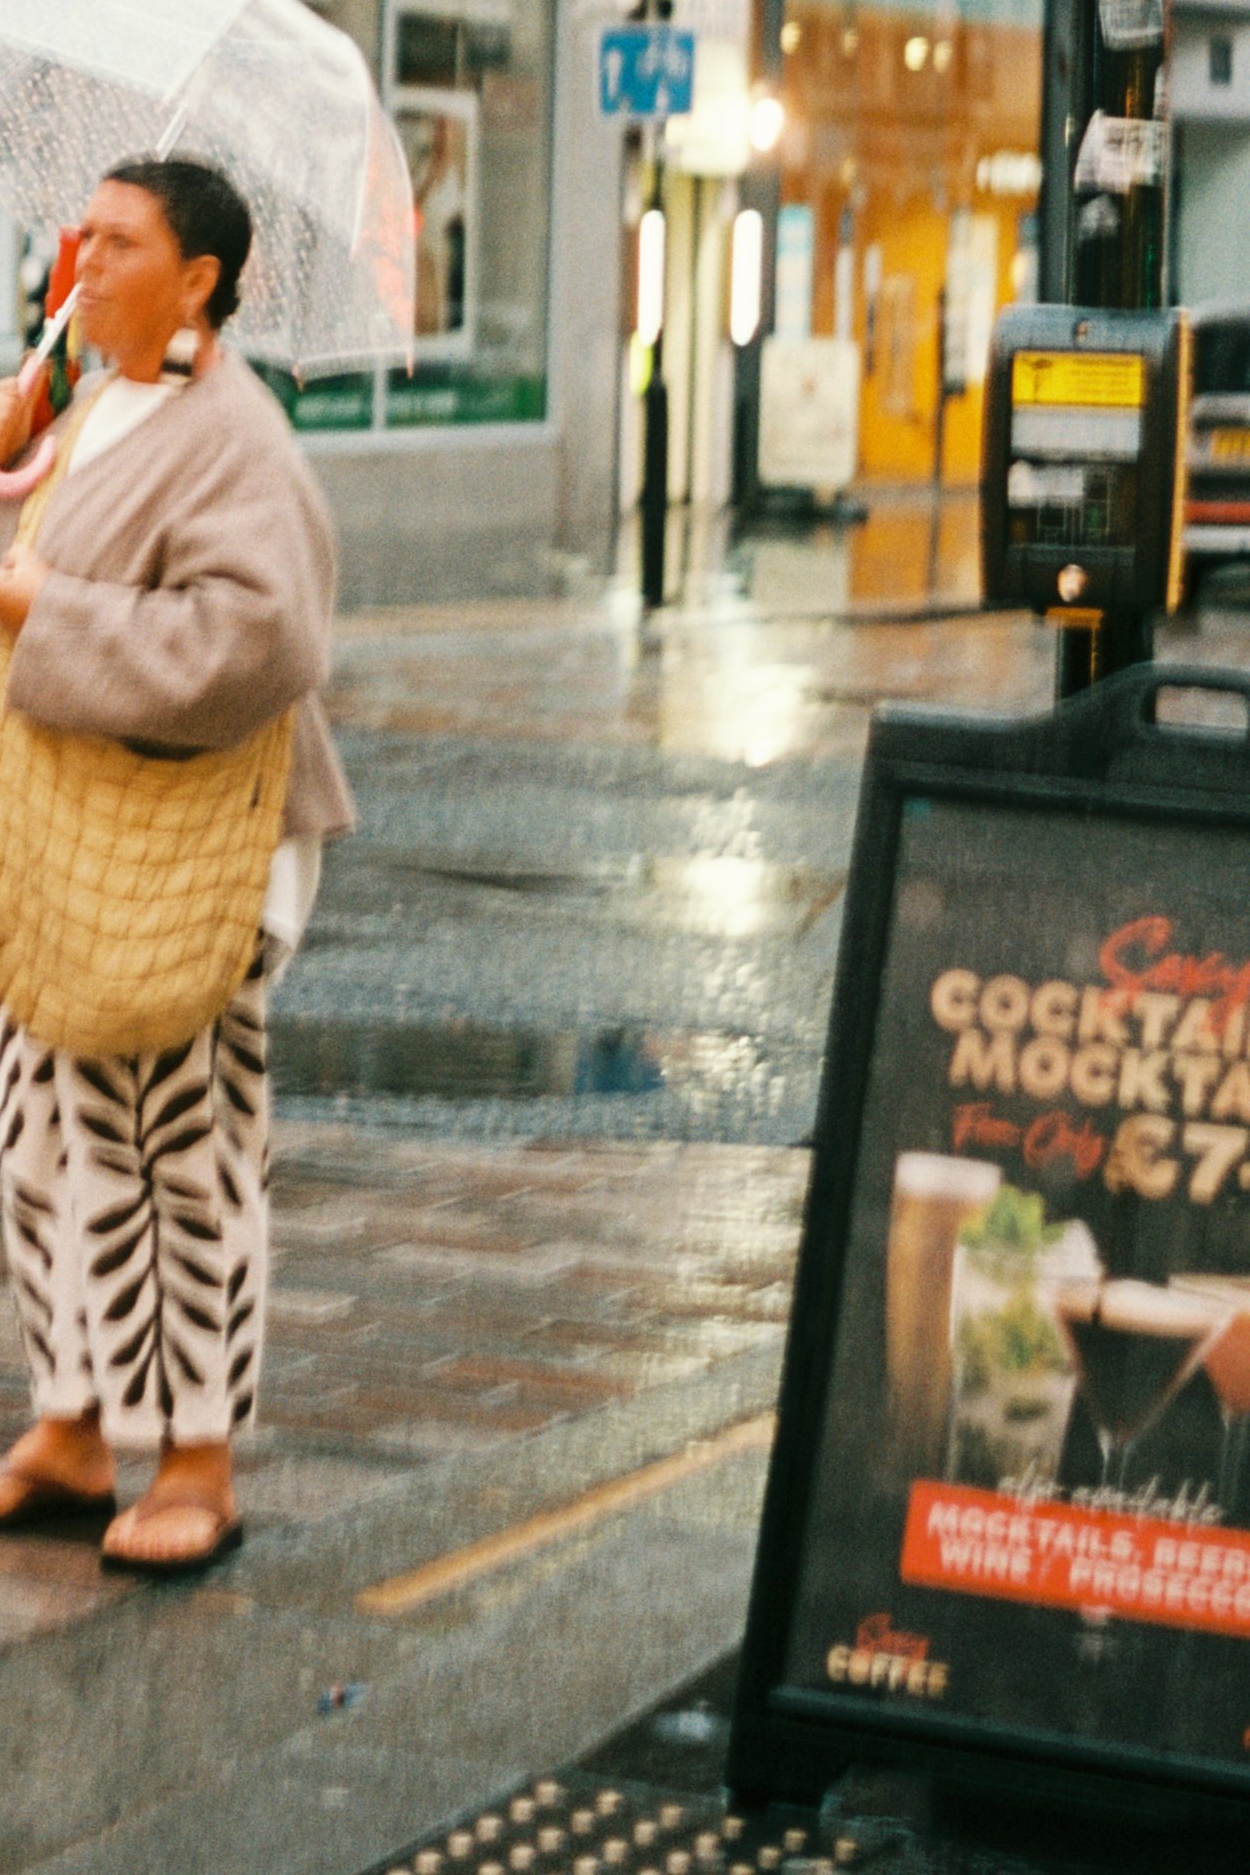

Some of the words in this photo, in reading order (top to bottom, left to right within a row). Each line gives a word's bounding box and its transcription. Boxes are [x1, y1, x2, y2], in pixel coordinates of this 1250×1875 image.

[930, 968, 1250, 1059] COCKTAI
[948, 1029, 1250, 1123] MOCKTA
[1152, 1537, 1250, 1582] BEER
